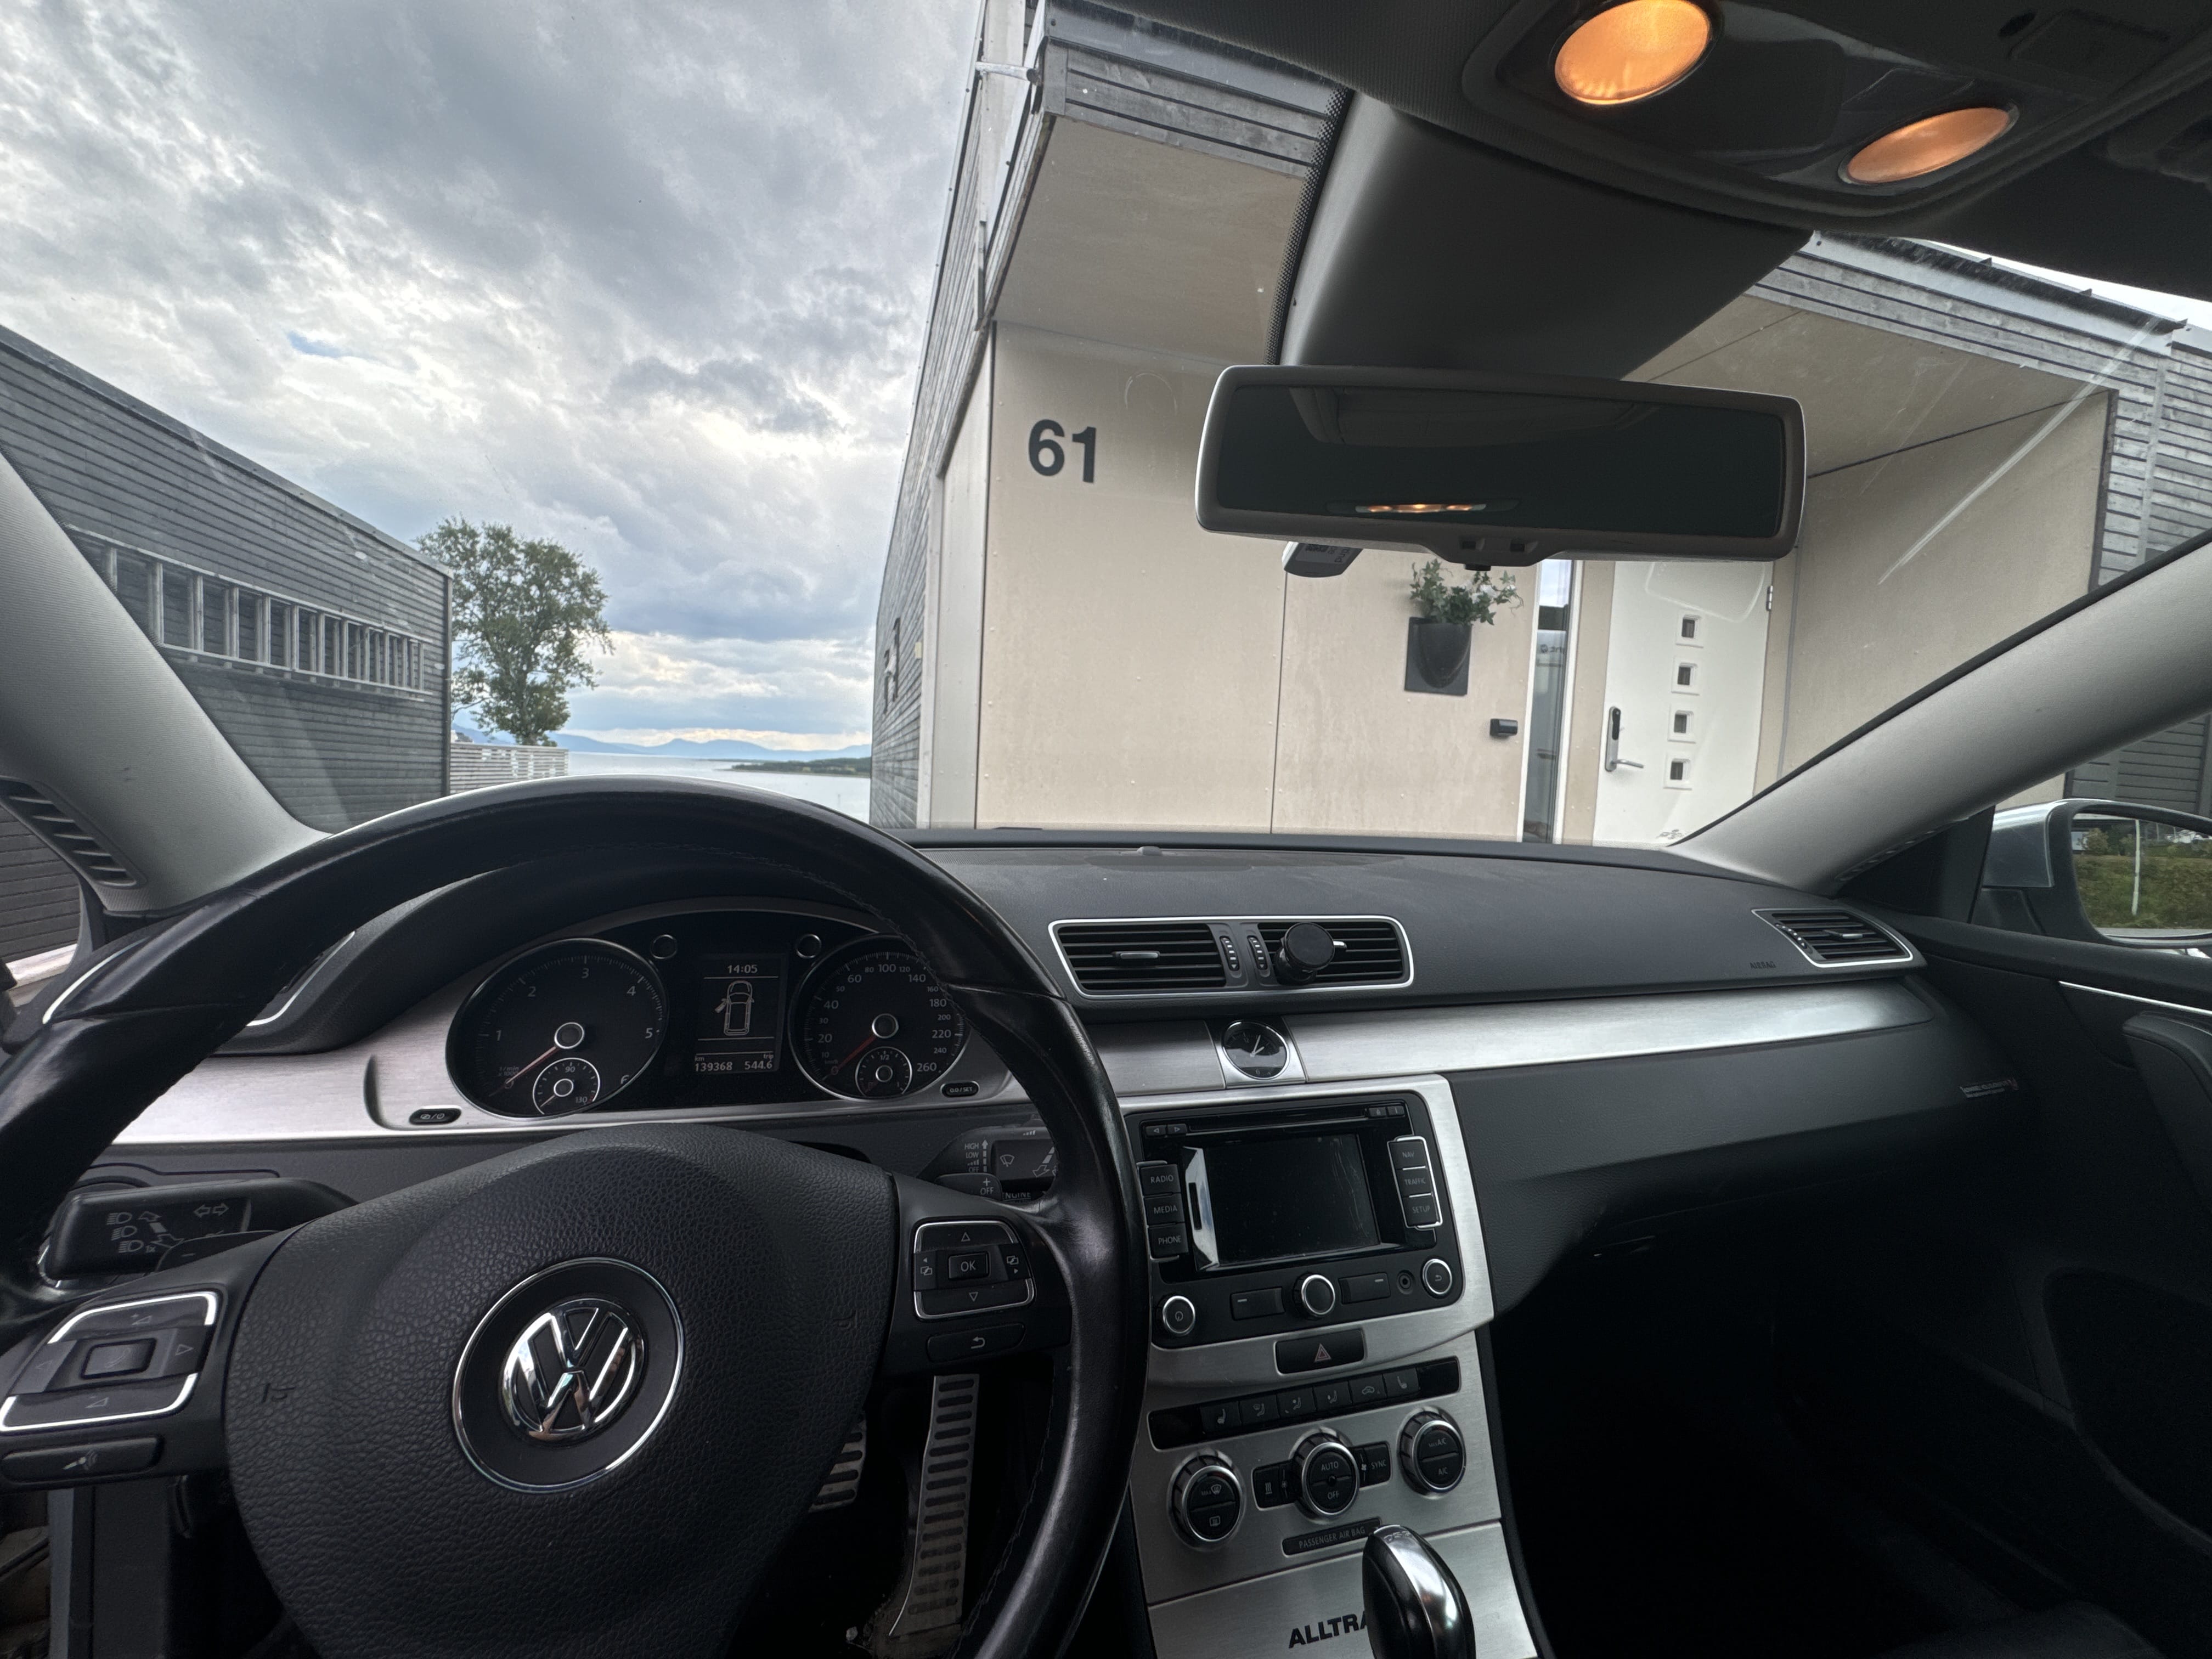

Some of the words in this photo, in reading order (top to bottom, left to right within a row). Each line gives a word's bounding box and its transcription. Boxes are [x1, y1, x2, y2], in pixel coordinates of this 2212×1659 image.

[1029, 420, 1096, 483] 61
[582, 968, 590, 979] 3
[727, 964, 758, 974] 14:05
[878, 964, 896, 973] 100
[847, 974, 862, 983] 60
[908, 974, 926, 983] 140
[527, 986, 537, 997] 2
[627, 985, 637, 996] 4
[823, 1000, 839, 1009] 40
[929, 998, 947, 1007] 180
[495, 1030, 502, 1041] 1
[645, 1027, 653, 1039] 5
[932, 1029, 952, 1039] 220
[817, 1034, 833, 1043] 20
[695, 1062, 733, 1072] 139368
[744, 1060, 773, 1070] 544.6
[916, 1063, 937, 1071] 260
[1150, 1175, 1174, 1184] RADIO
[980, 1187, 994, 1195] OFF
[1153, 1205, 1178, 1215] MEDIA
[1412, 1205, 1431, 1214] SETUP
[1158, 1235, 1181, 1245] PHONE
[961, 1260, 977, 1272] OK
[1321, 1460, 1339, 1471] AUTO
[1370, 1459, 1387, 1470] SYNC
[1438, 1466, 1448, 1475] A/C
[1327, 1491, 1339, 1500] OFF
[1298, 1532, 1338, 1549] PASSENGER
[1339, 1530, 1351, 1541] AIR
[1351, 1527, 1365, 1537] BAG
